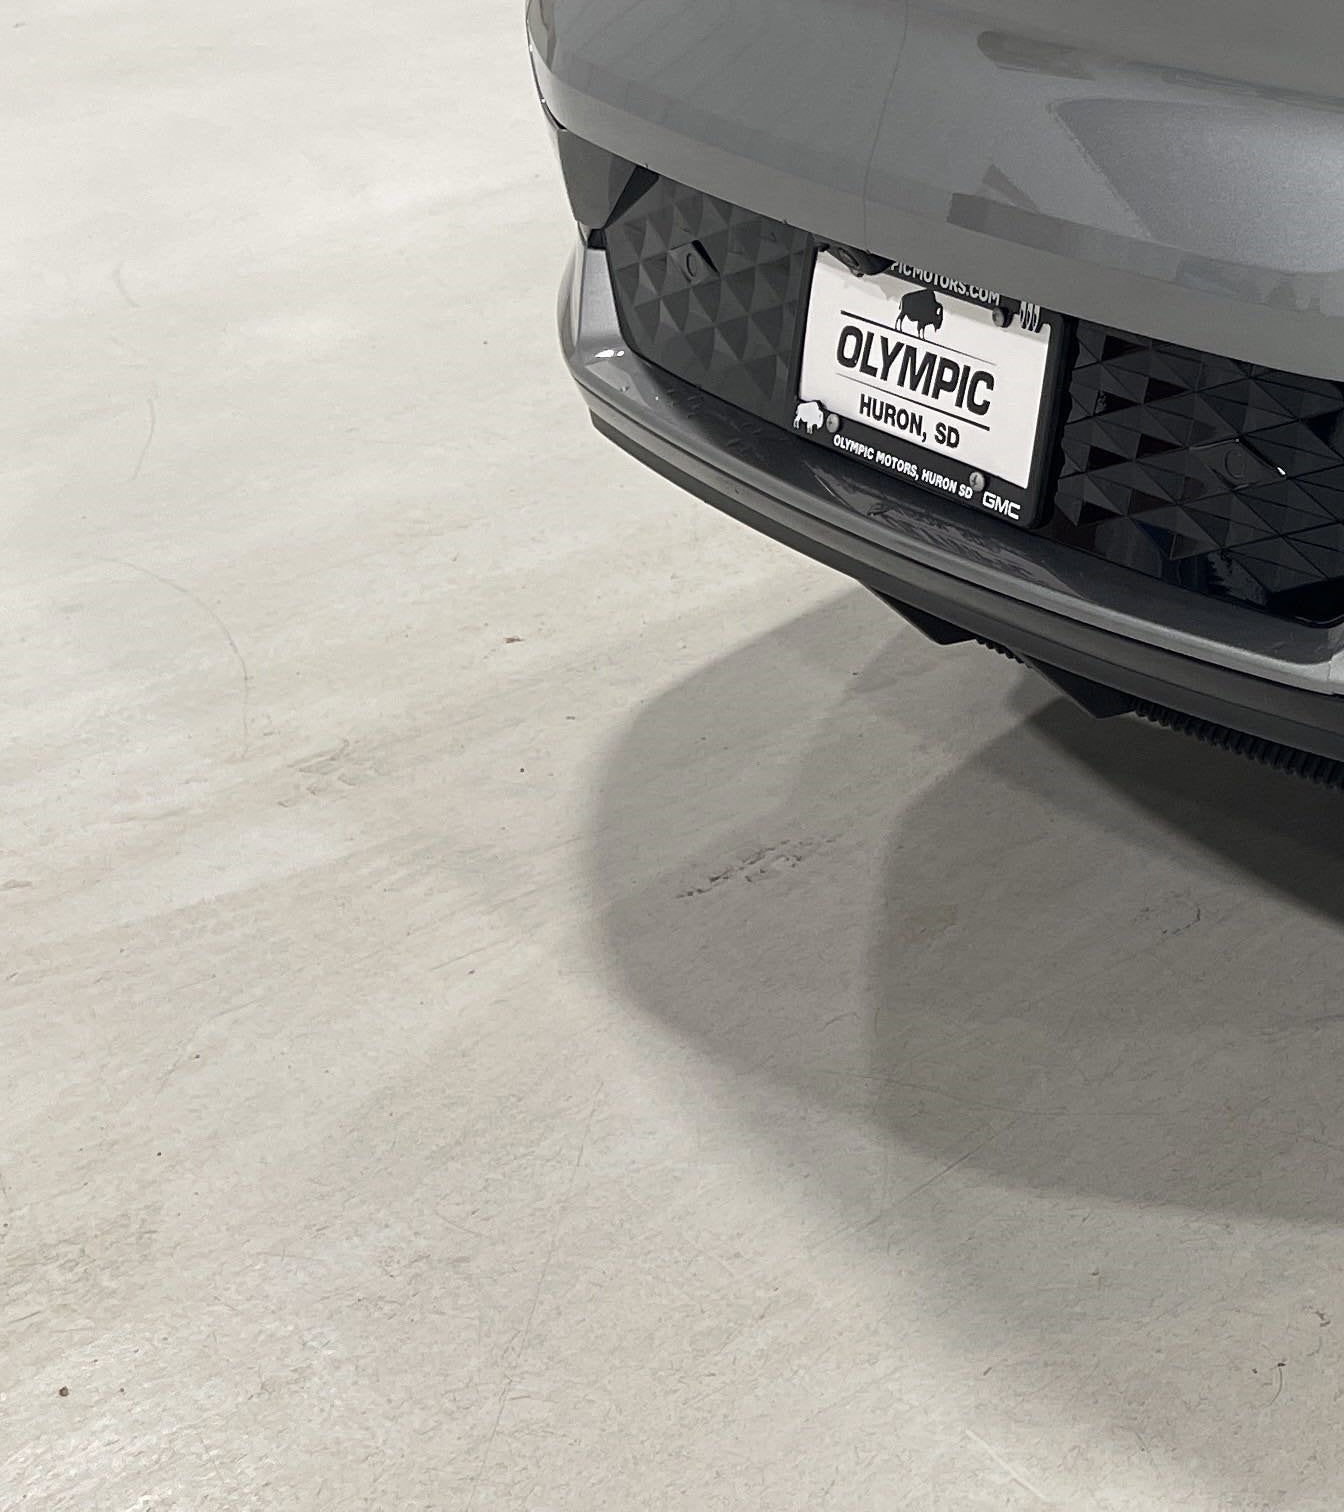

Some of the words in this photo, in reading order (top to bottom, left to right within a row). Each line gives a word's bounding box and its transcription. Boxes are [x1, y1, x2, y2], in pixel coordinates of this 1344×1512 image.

[836, 325, 995, 416] OLYMPIC
[859, 393, 927, 443] HURON,
[934, 422, 961, 450] SD
[833, 434, 875, 461] OLYMPIC
[875, 450, 919, 481] MOTORS,
[921, 468, 958, 494] HURON
[958, 483, 973, 500] SD
[982, 491, 1021, 520] GMC
